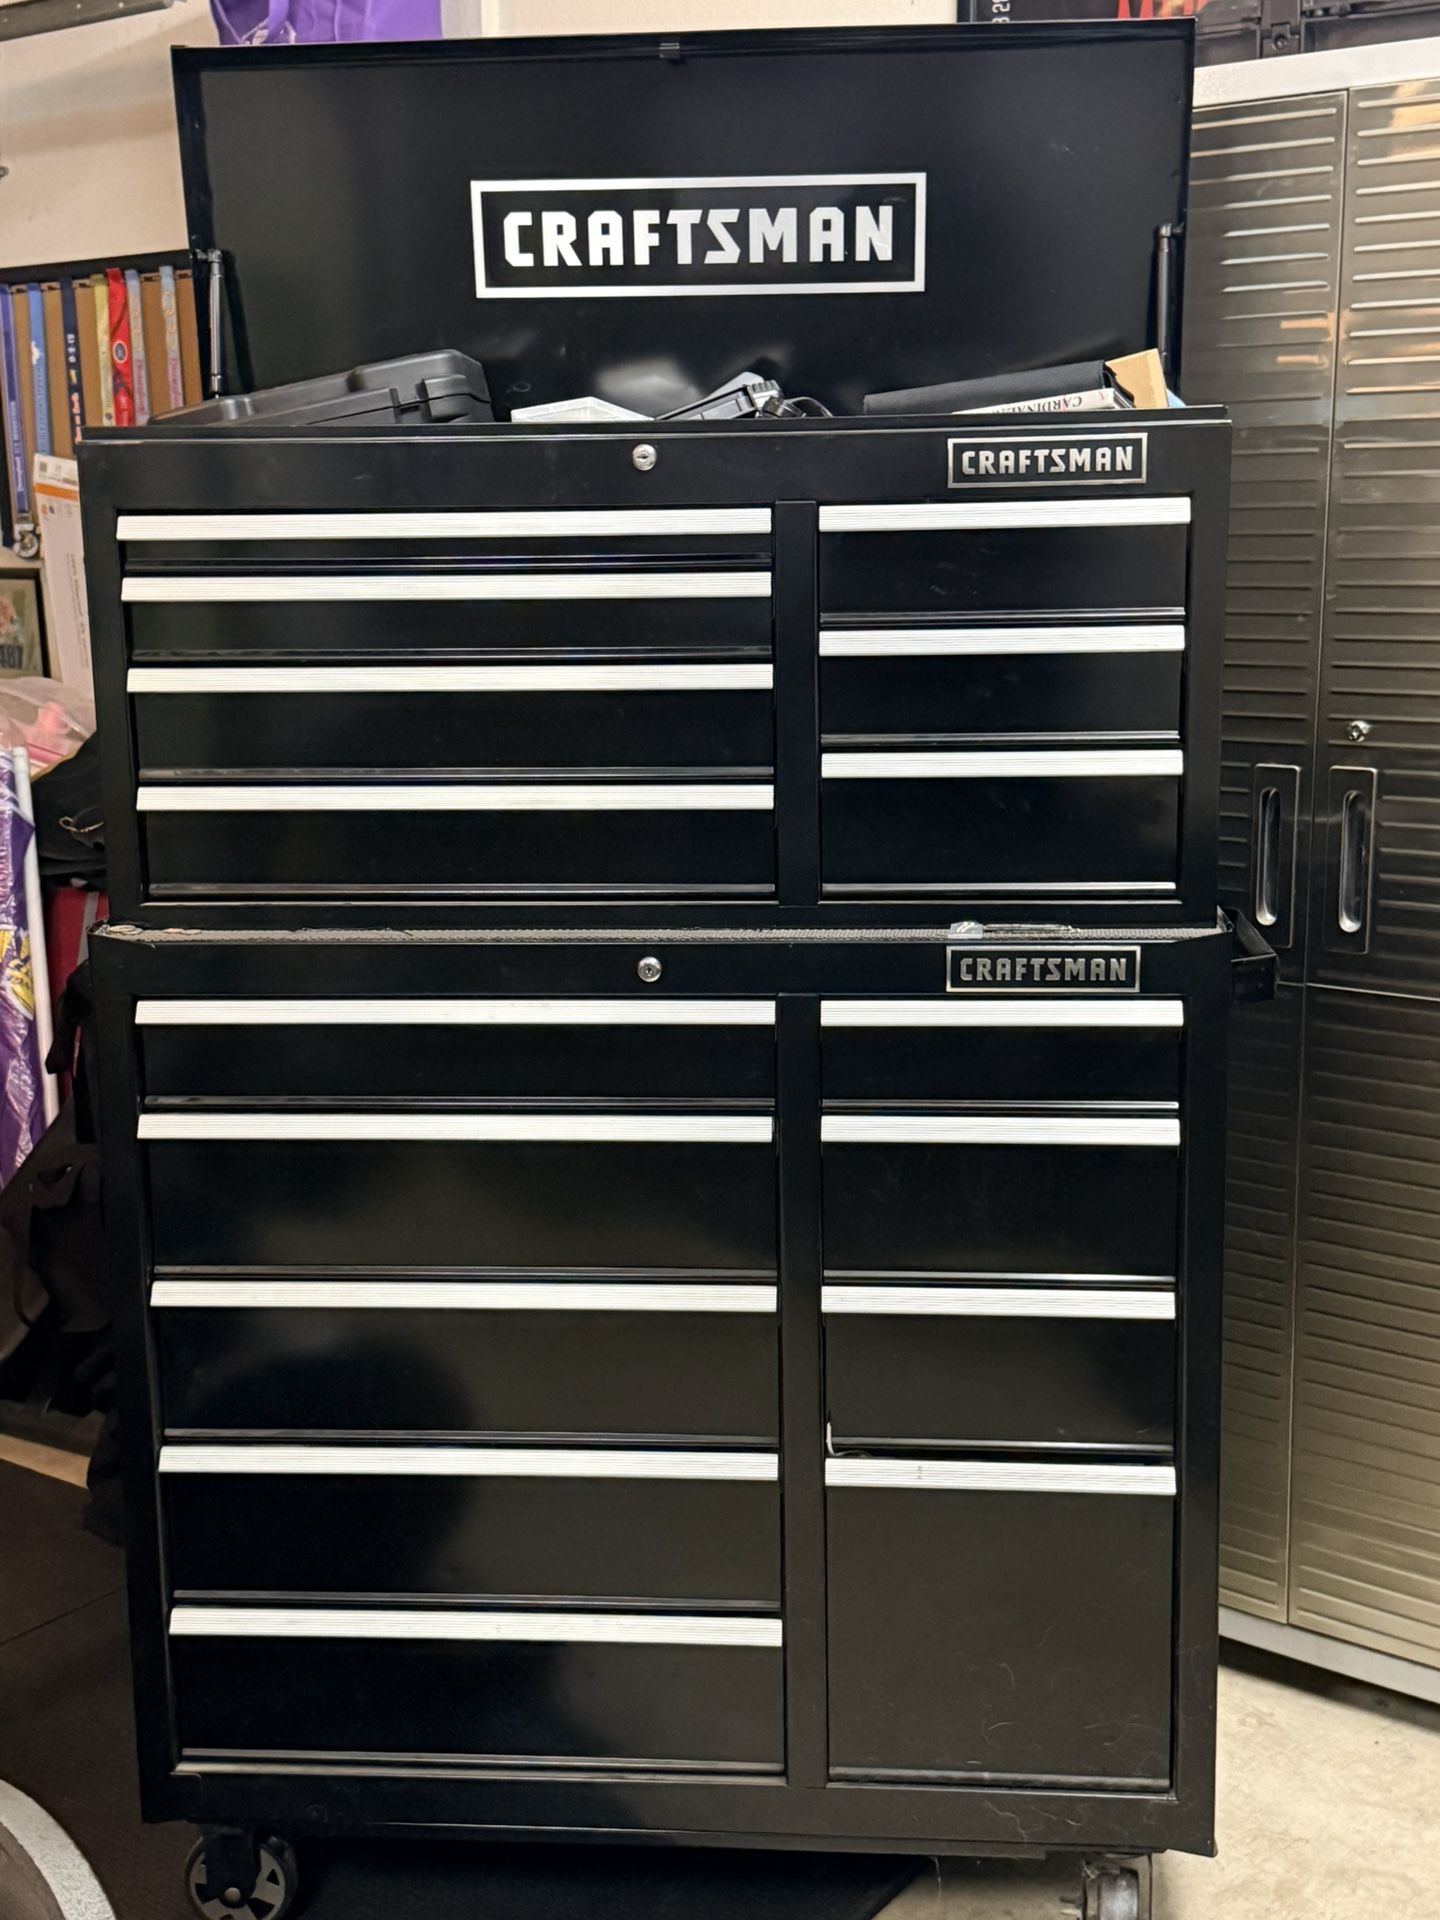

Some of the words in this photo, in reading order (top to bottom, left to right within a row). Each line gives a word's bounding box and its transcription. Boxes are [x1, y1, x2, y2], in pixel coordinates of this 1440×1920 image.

[991, 0, 1010, 13] 2
[503, 205, 893, 267] CRAFTSMAN
[961, 446, 1133, 475] CRAFTSMAN
[960, 957, 1127, 982] CRAFTSMAN
